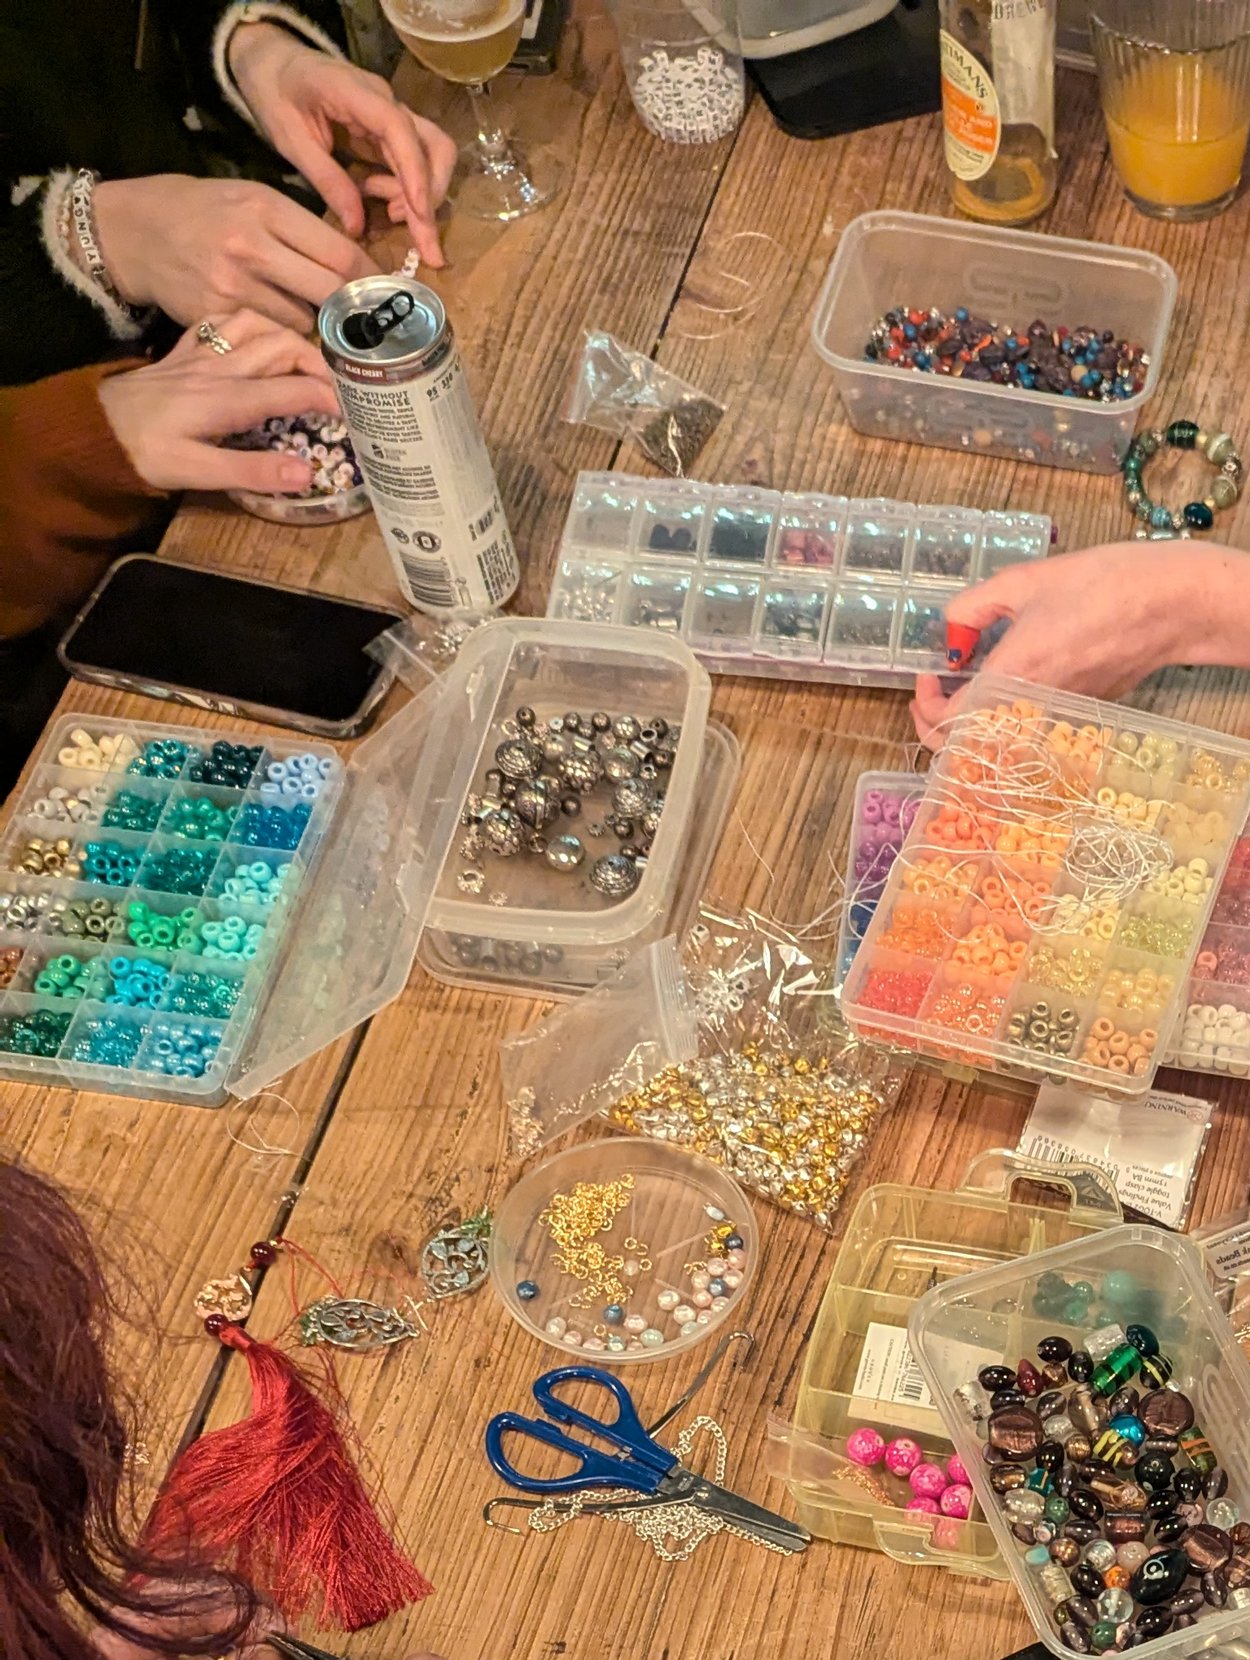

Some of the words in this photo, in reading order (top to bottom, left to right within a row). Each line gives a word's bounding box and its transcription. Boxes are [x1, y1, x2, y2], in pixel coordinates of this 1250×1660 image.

[74, 207, 98, 262] YUNG
[345, 364, 360, 375] BLACK
[362, 369, 383, 377] CHERRY
[361, 391, 408, 399] WITHOUT
[427, 386, 438, 397] 95
[1132, 1172, 1143, 1181] BA
[1125, 1180, 1146, 1192] clasp
[1118, 1189, 1149, 1205] Findings
[1146, 1186, 1170, 1199] toggle
[1149, 1199, 1172, 1211] Value
